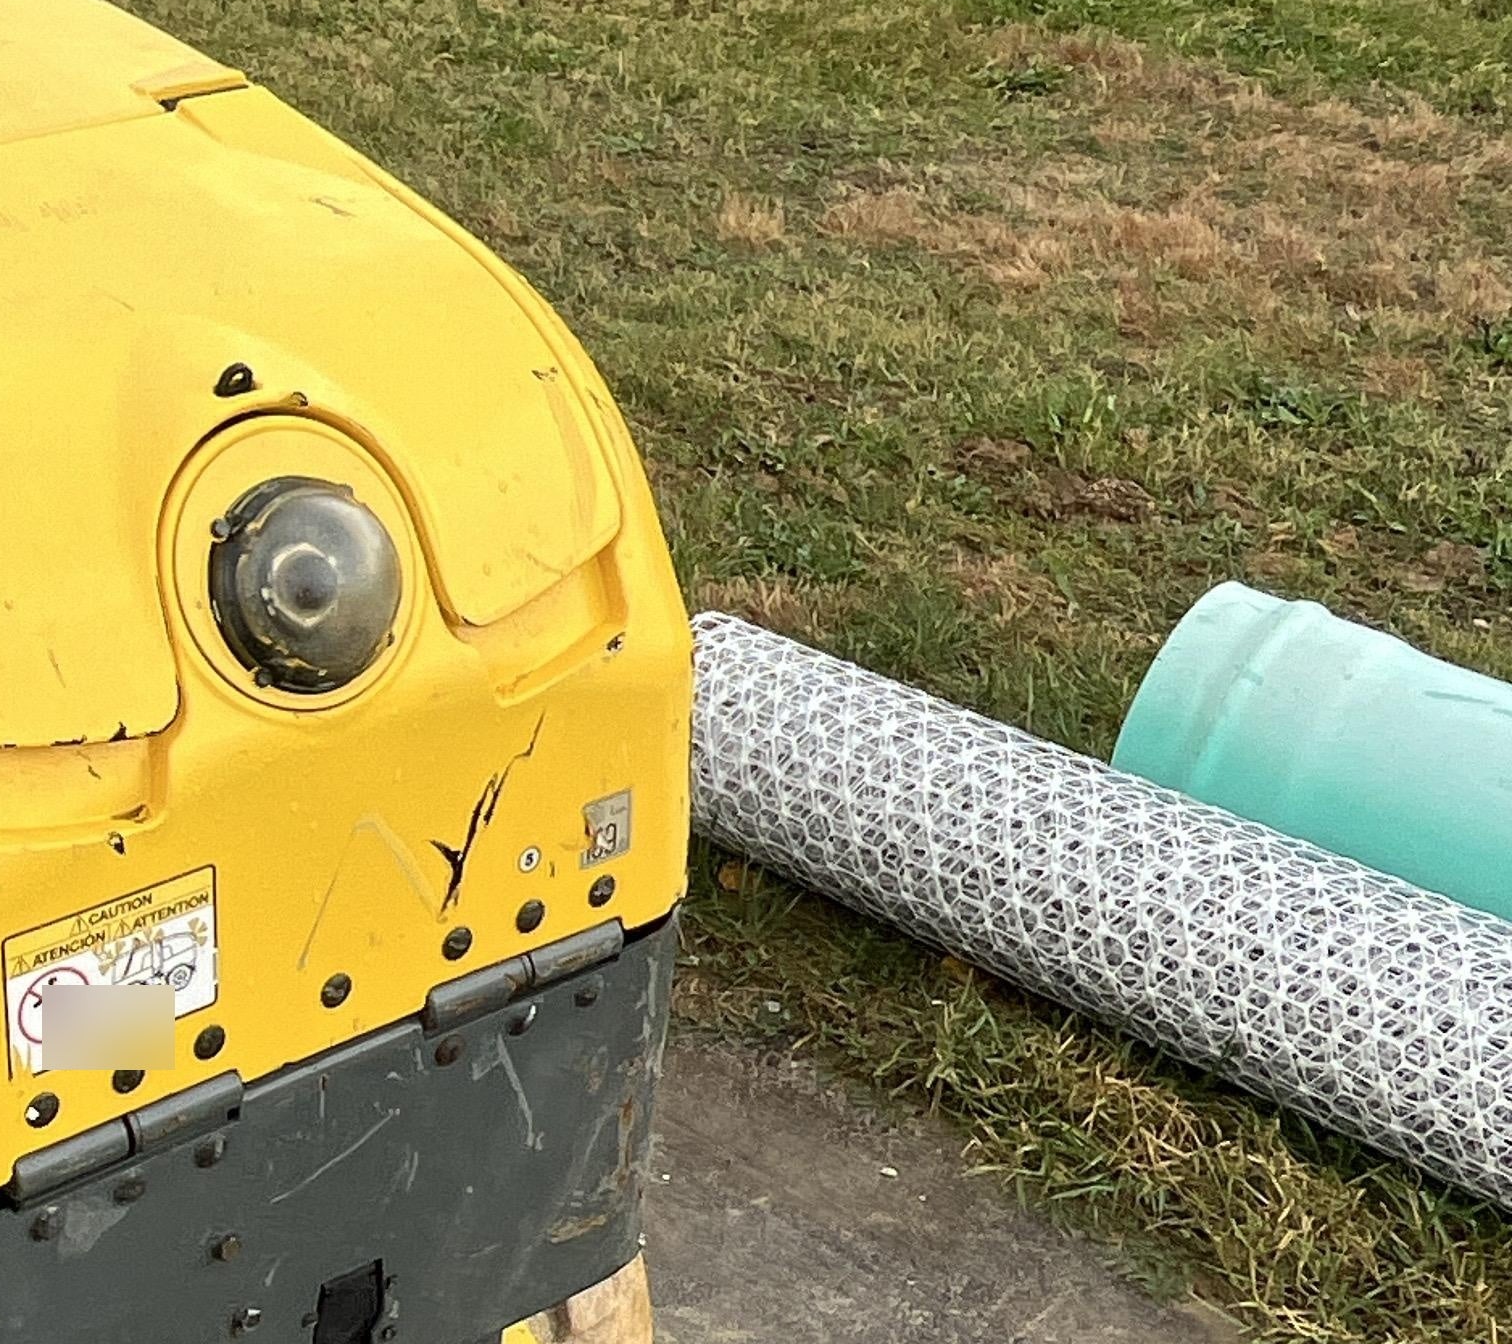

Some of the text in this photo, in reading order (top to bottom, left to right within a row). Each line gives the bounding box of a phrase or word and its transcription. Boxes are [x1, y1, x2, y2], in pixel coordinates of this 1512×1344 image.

[87, 892, 154, 926] CAUTION
[131, 890, 210, 930] ATTENTION
[31, 929, 107, 968] ATENCIÓN
